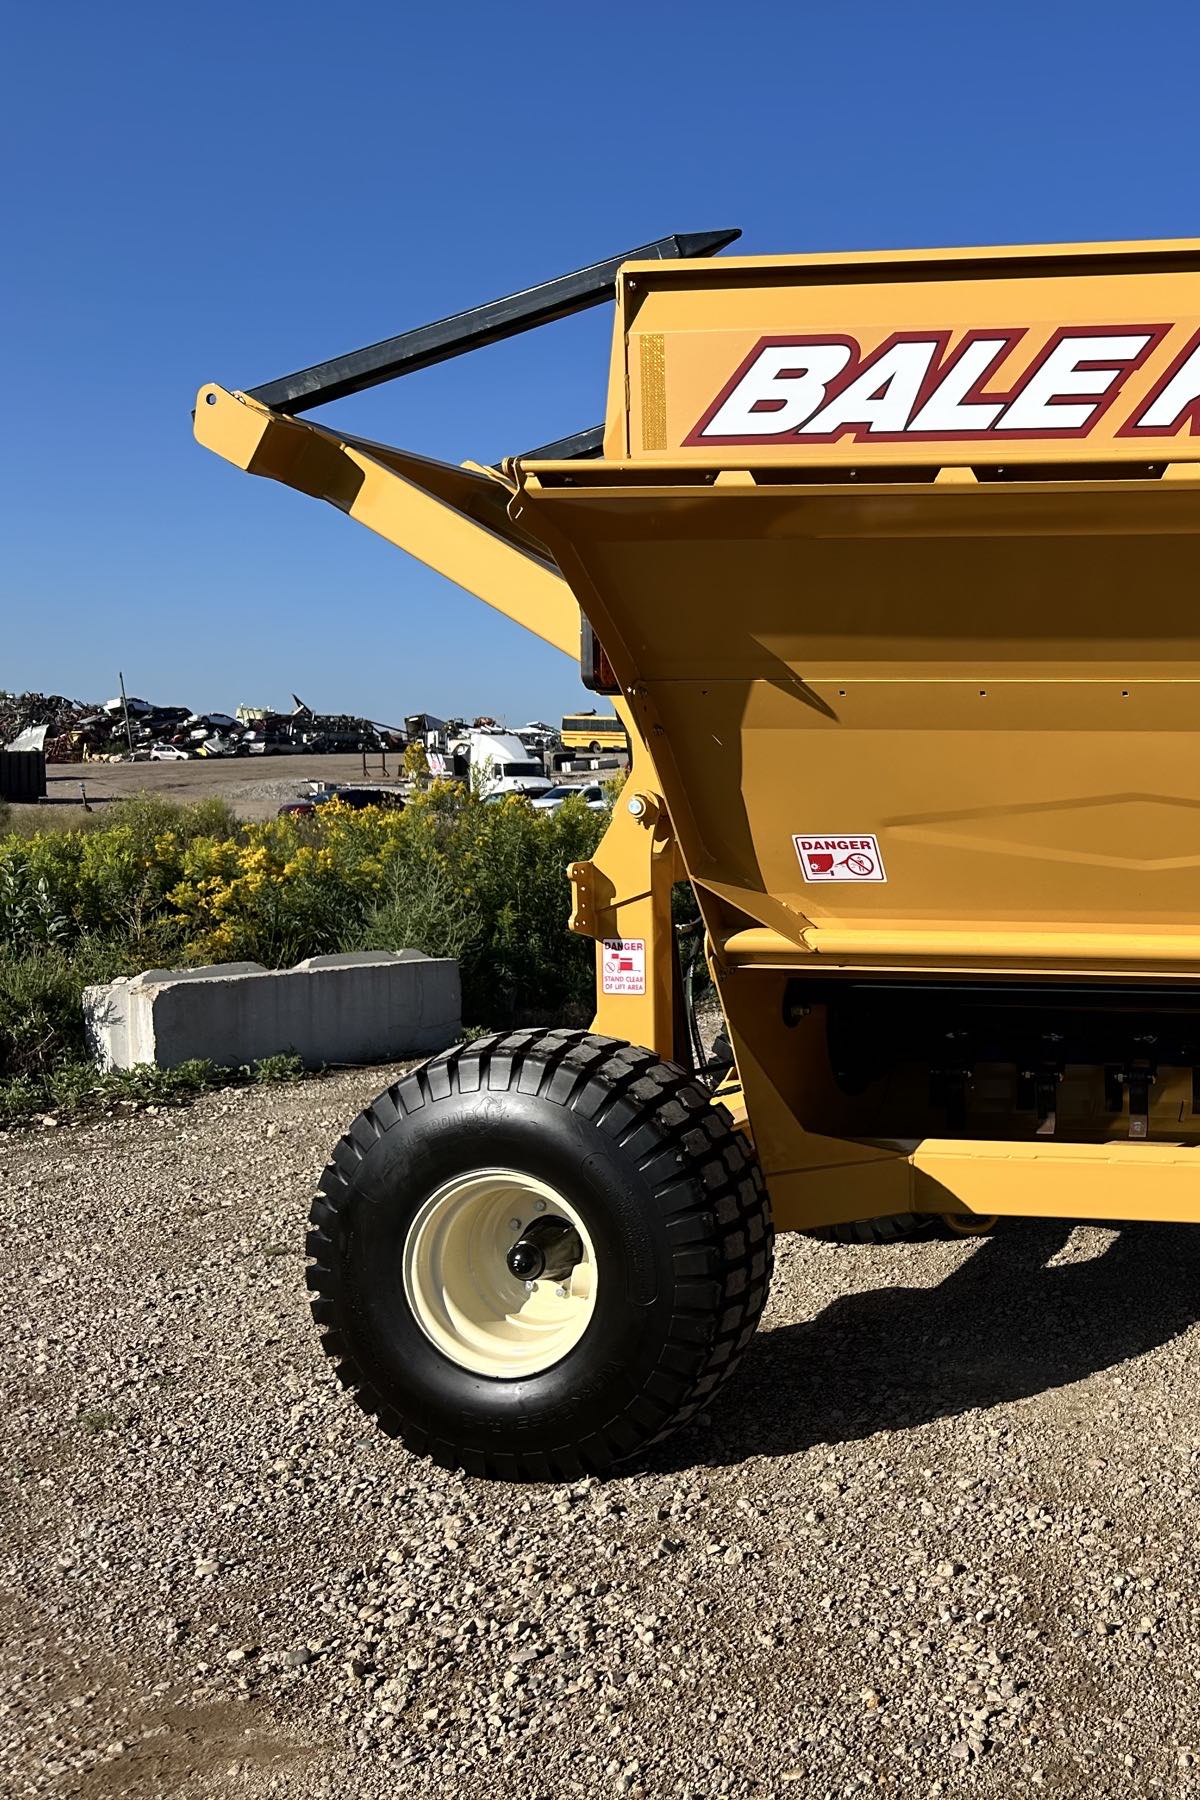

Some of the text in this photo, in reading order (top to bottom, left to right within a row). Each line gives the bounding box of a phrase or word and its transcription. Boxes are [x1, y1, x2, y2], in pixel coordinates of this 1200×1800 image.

[692, 331, 1162, 439] BALE
[800, 841, 872, 850] DANGER
[604, 942, 643, 951] DANGER
